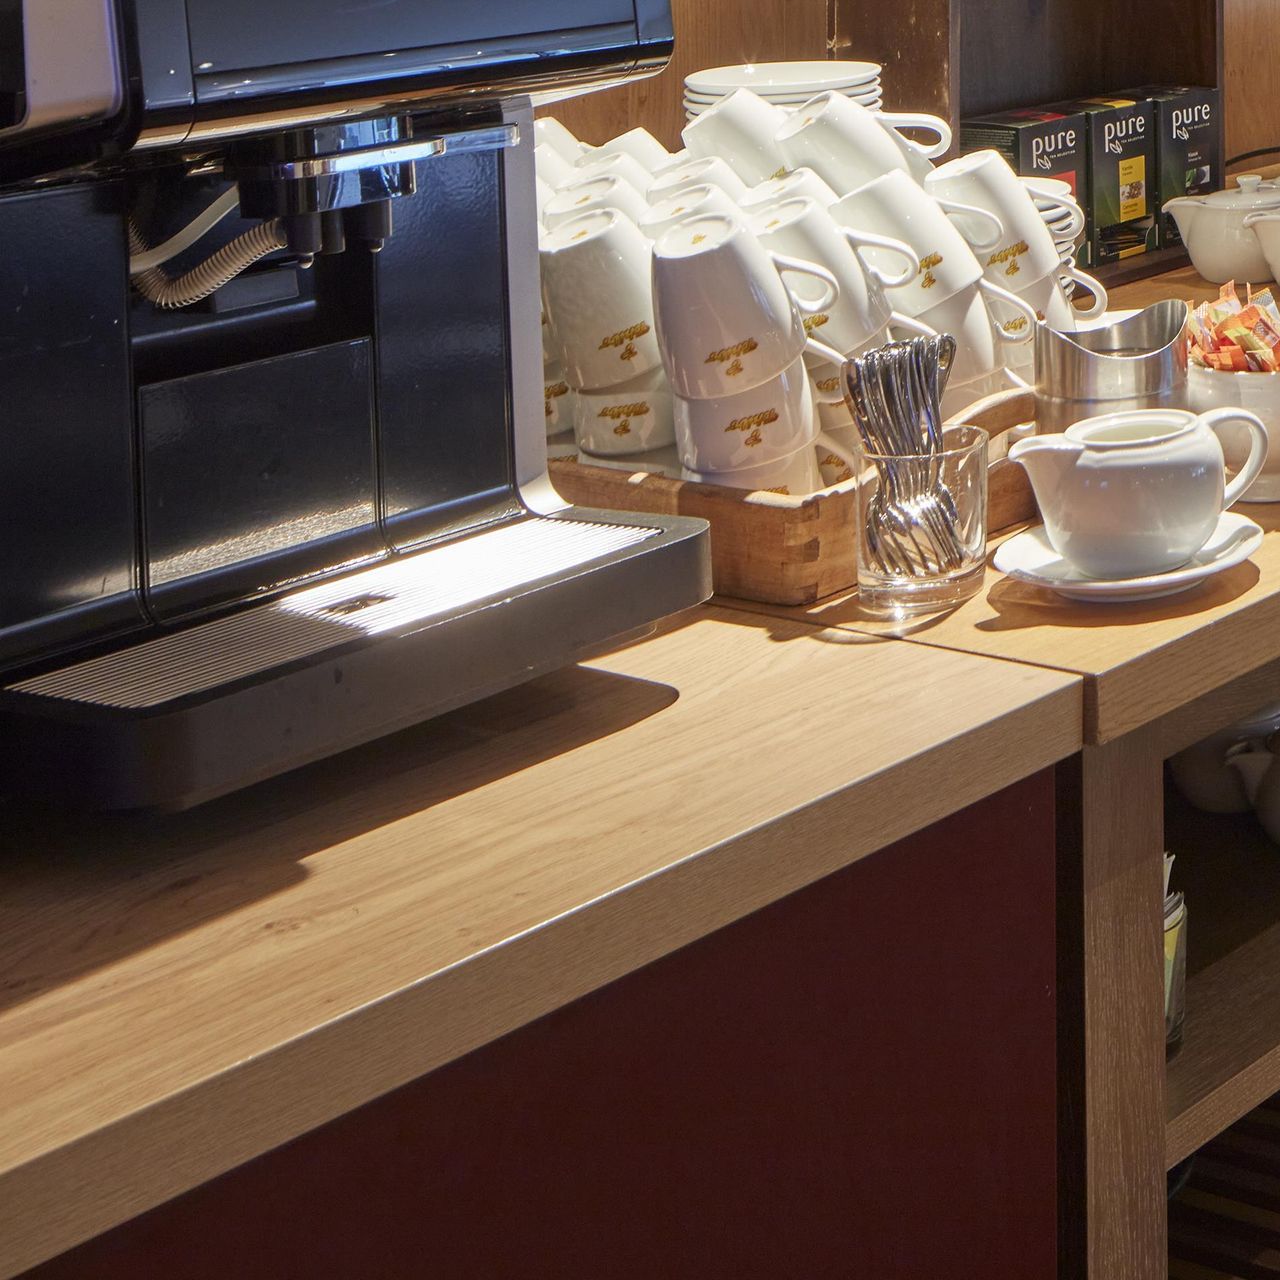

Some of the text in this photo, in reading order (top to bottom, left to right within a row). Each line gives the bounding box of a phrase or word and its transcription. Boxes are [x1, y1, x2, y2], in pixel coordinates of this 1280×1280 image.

[1104, 115, 1145, 153] pure
[1172, 103, 1211, 139] pure
[1032, 129, 1076, 168] pure
